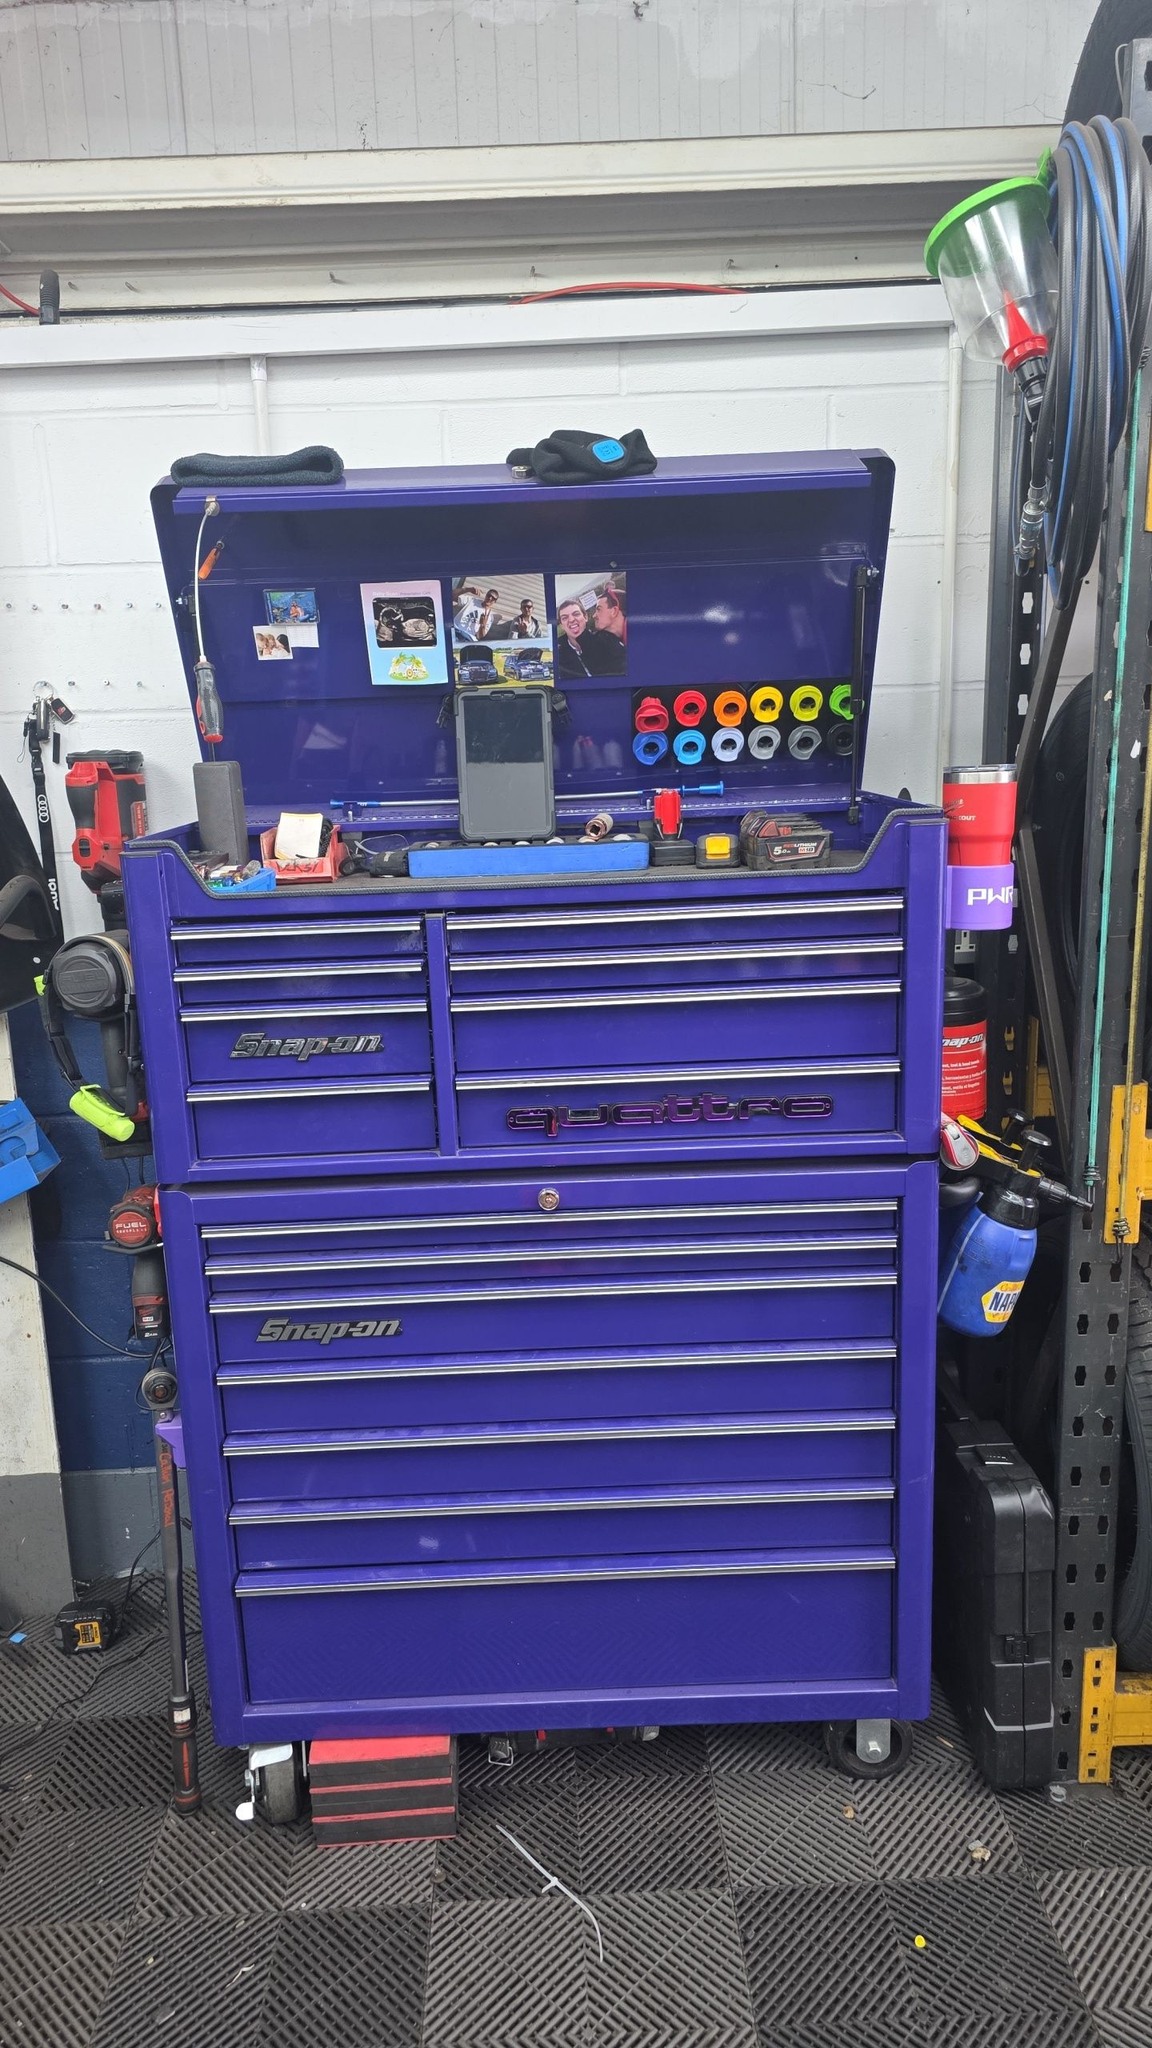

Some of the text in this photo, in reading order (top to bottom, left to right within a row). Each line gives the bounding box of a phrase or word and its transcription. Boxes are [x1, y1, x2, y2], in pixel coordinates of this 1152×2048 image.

[229, 1032, 382, 1061] Snap-on
[942, 1033, 985, 1048] nap-on
[506, 1092, 834, 1137] quattro
[115, 1221, 147, 1229] FUEL
[255, 1316, 402, 1345] Snap-on
